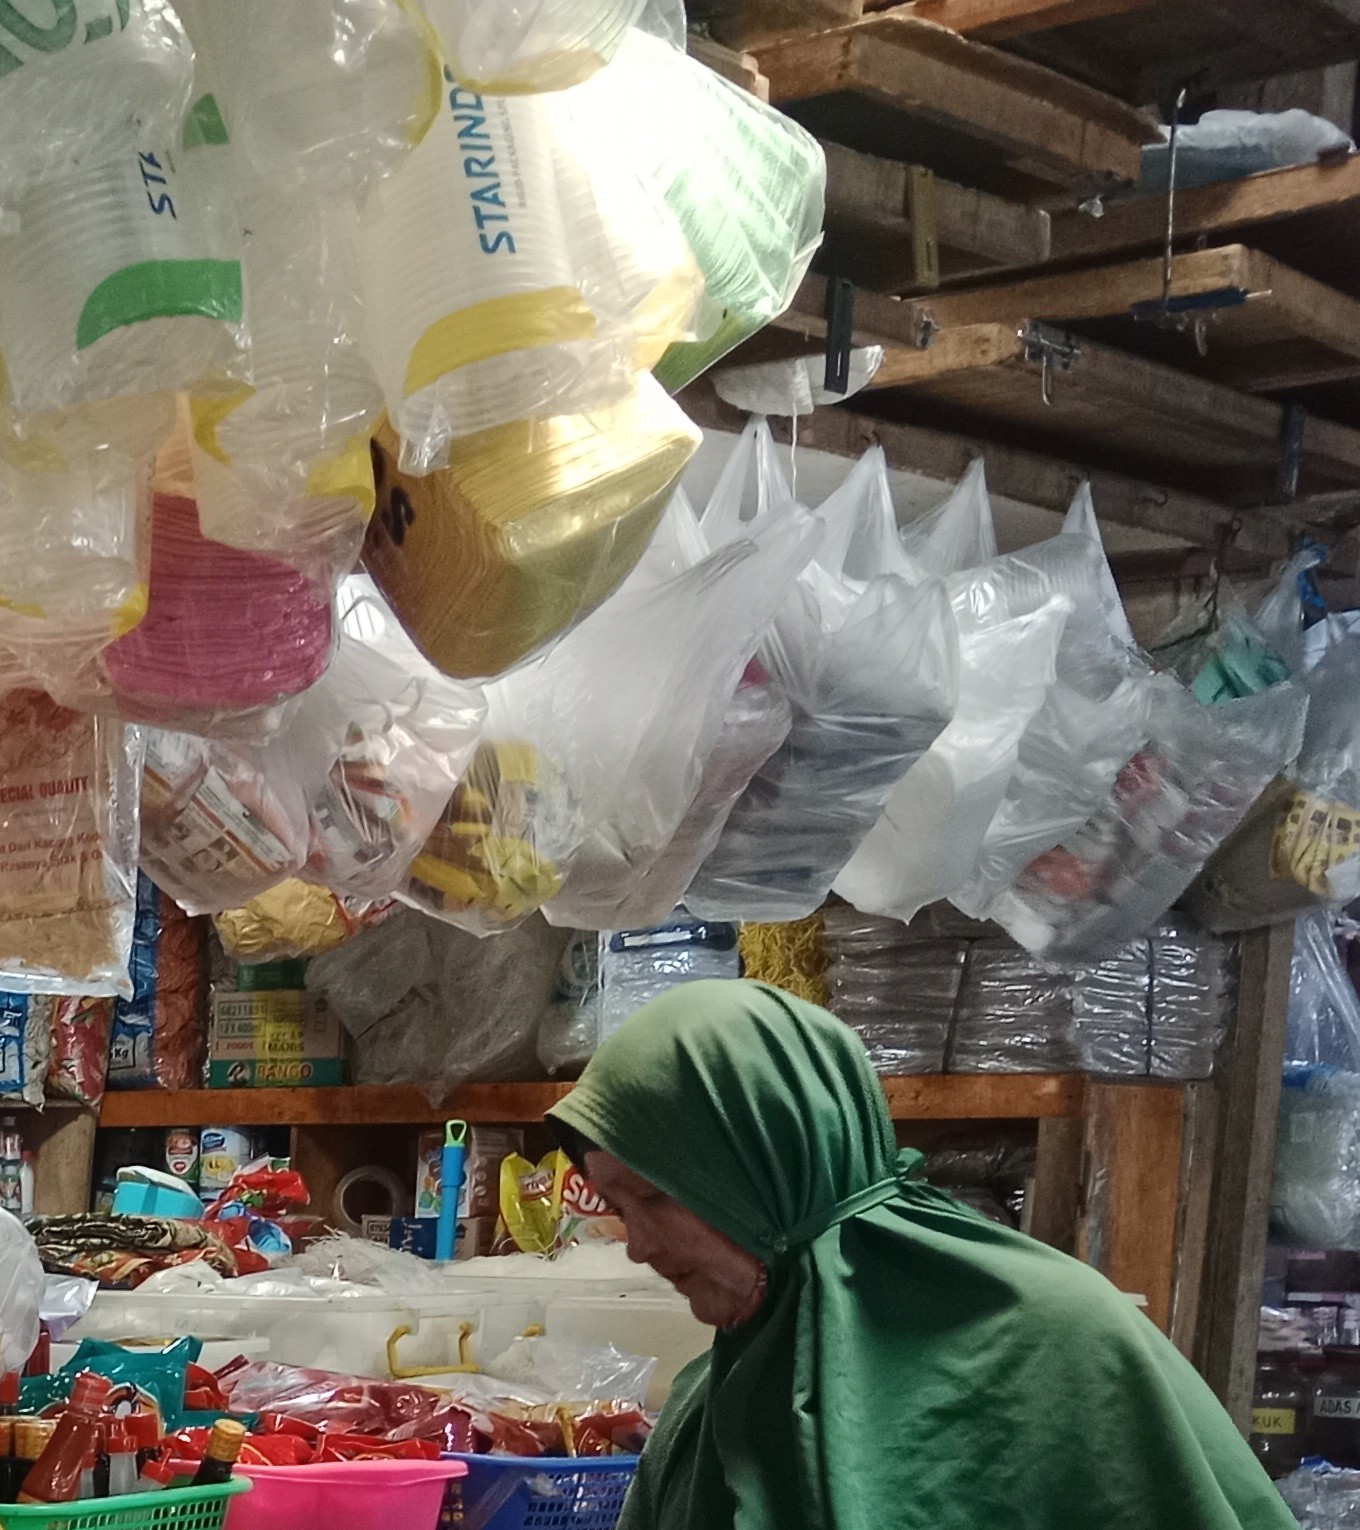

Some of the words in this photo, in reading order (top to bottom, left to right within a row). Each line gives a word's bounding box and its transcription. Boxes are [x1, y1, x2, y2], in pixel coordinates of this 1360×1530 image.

[444, 63, 516, 254] STARIND
[39, 776, 89, 797] QUALITY
[8, 842, 31, 853] Dari
[254, 1061, 314, 1079] BANGO
